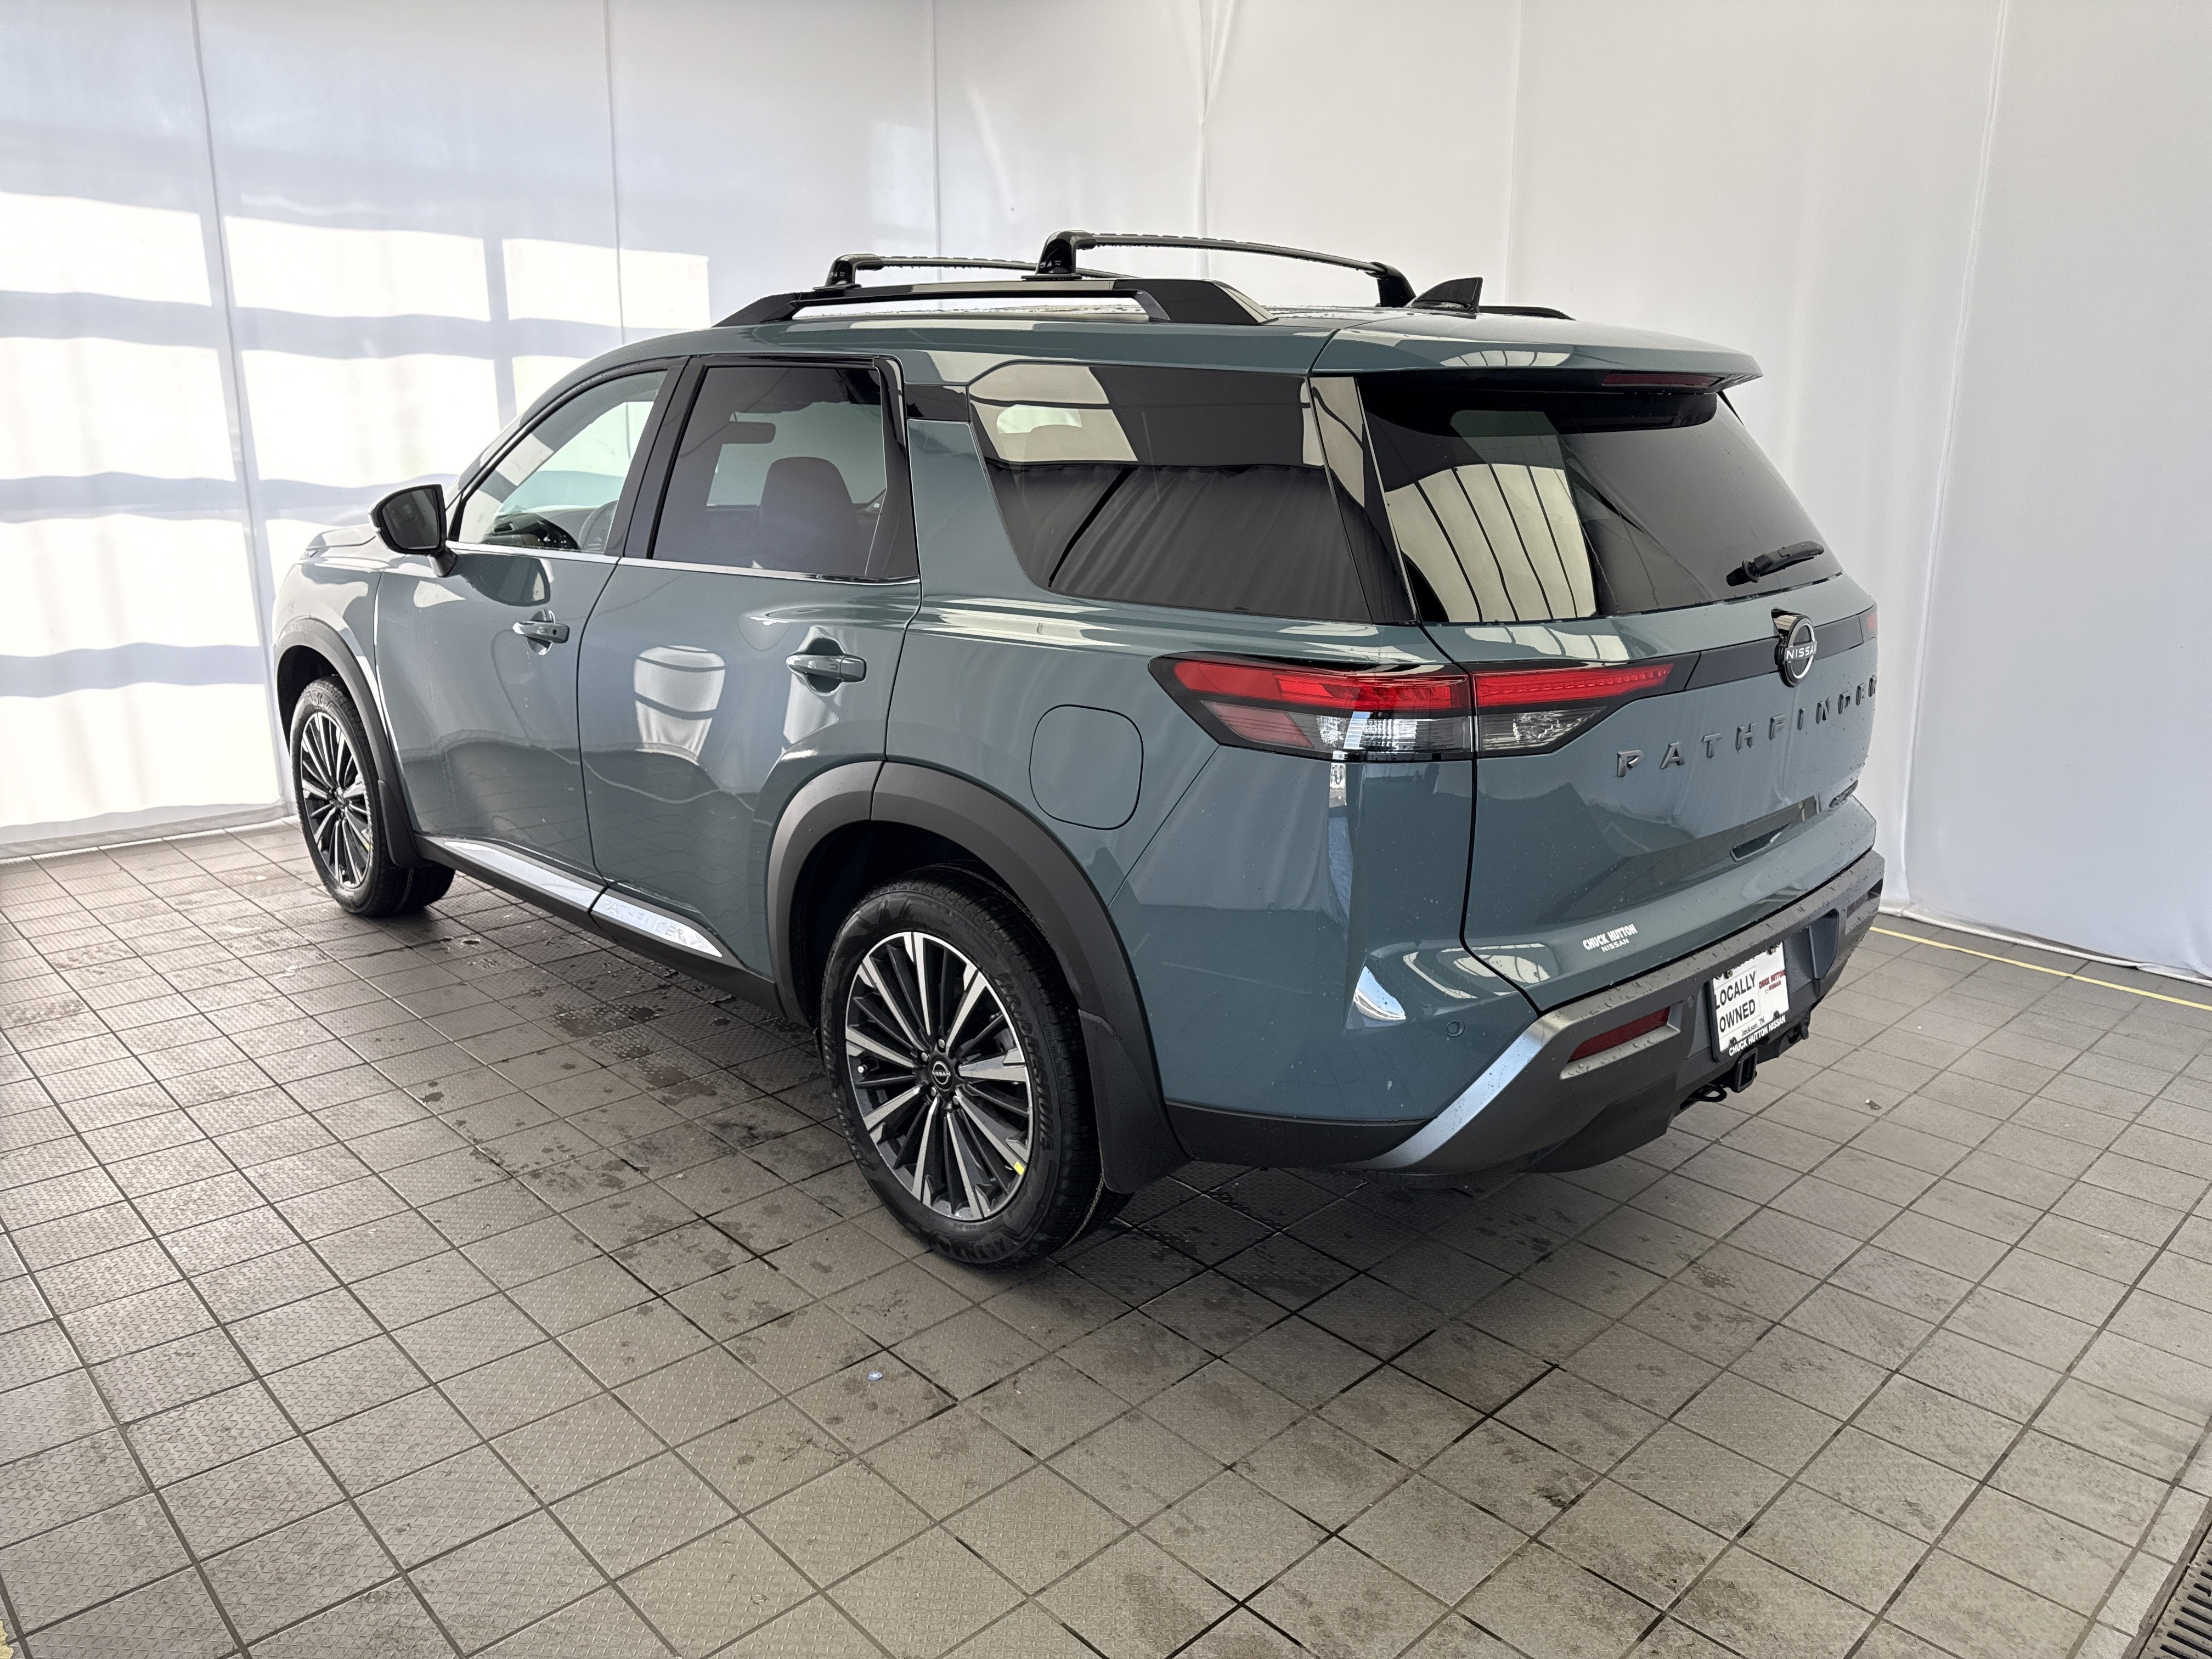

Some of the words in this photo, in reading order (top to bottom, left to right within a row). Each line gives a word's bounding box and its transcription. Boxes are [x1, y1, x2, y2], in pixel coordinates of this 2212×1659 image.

[1786, 644, 1817, 660] NISSAN
[1583, 933, 1610, 950] CHUCK
[1607, 923, 1638, 941] HUTTON
[1601, 938, 1630, 952] NISSAN
[1715, 970, 1756, 1010] LOCALLY
[1719, 998, 1756, 1033] OWNED
[1759, 1016, 1765, 1026] TN
[1729, 1038, 1748, 1056] CHUCK
[1748, 1025, 1769, 1046] HUTTON
[1768, 1014, 1786, 1032] NISSAN
